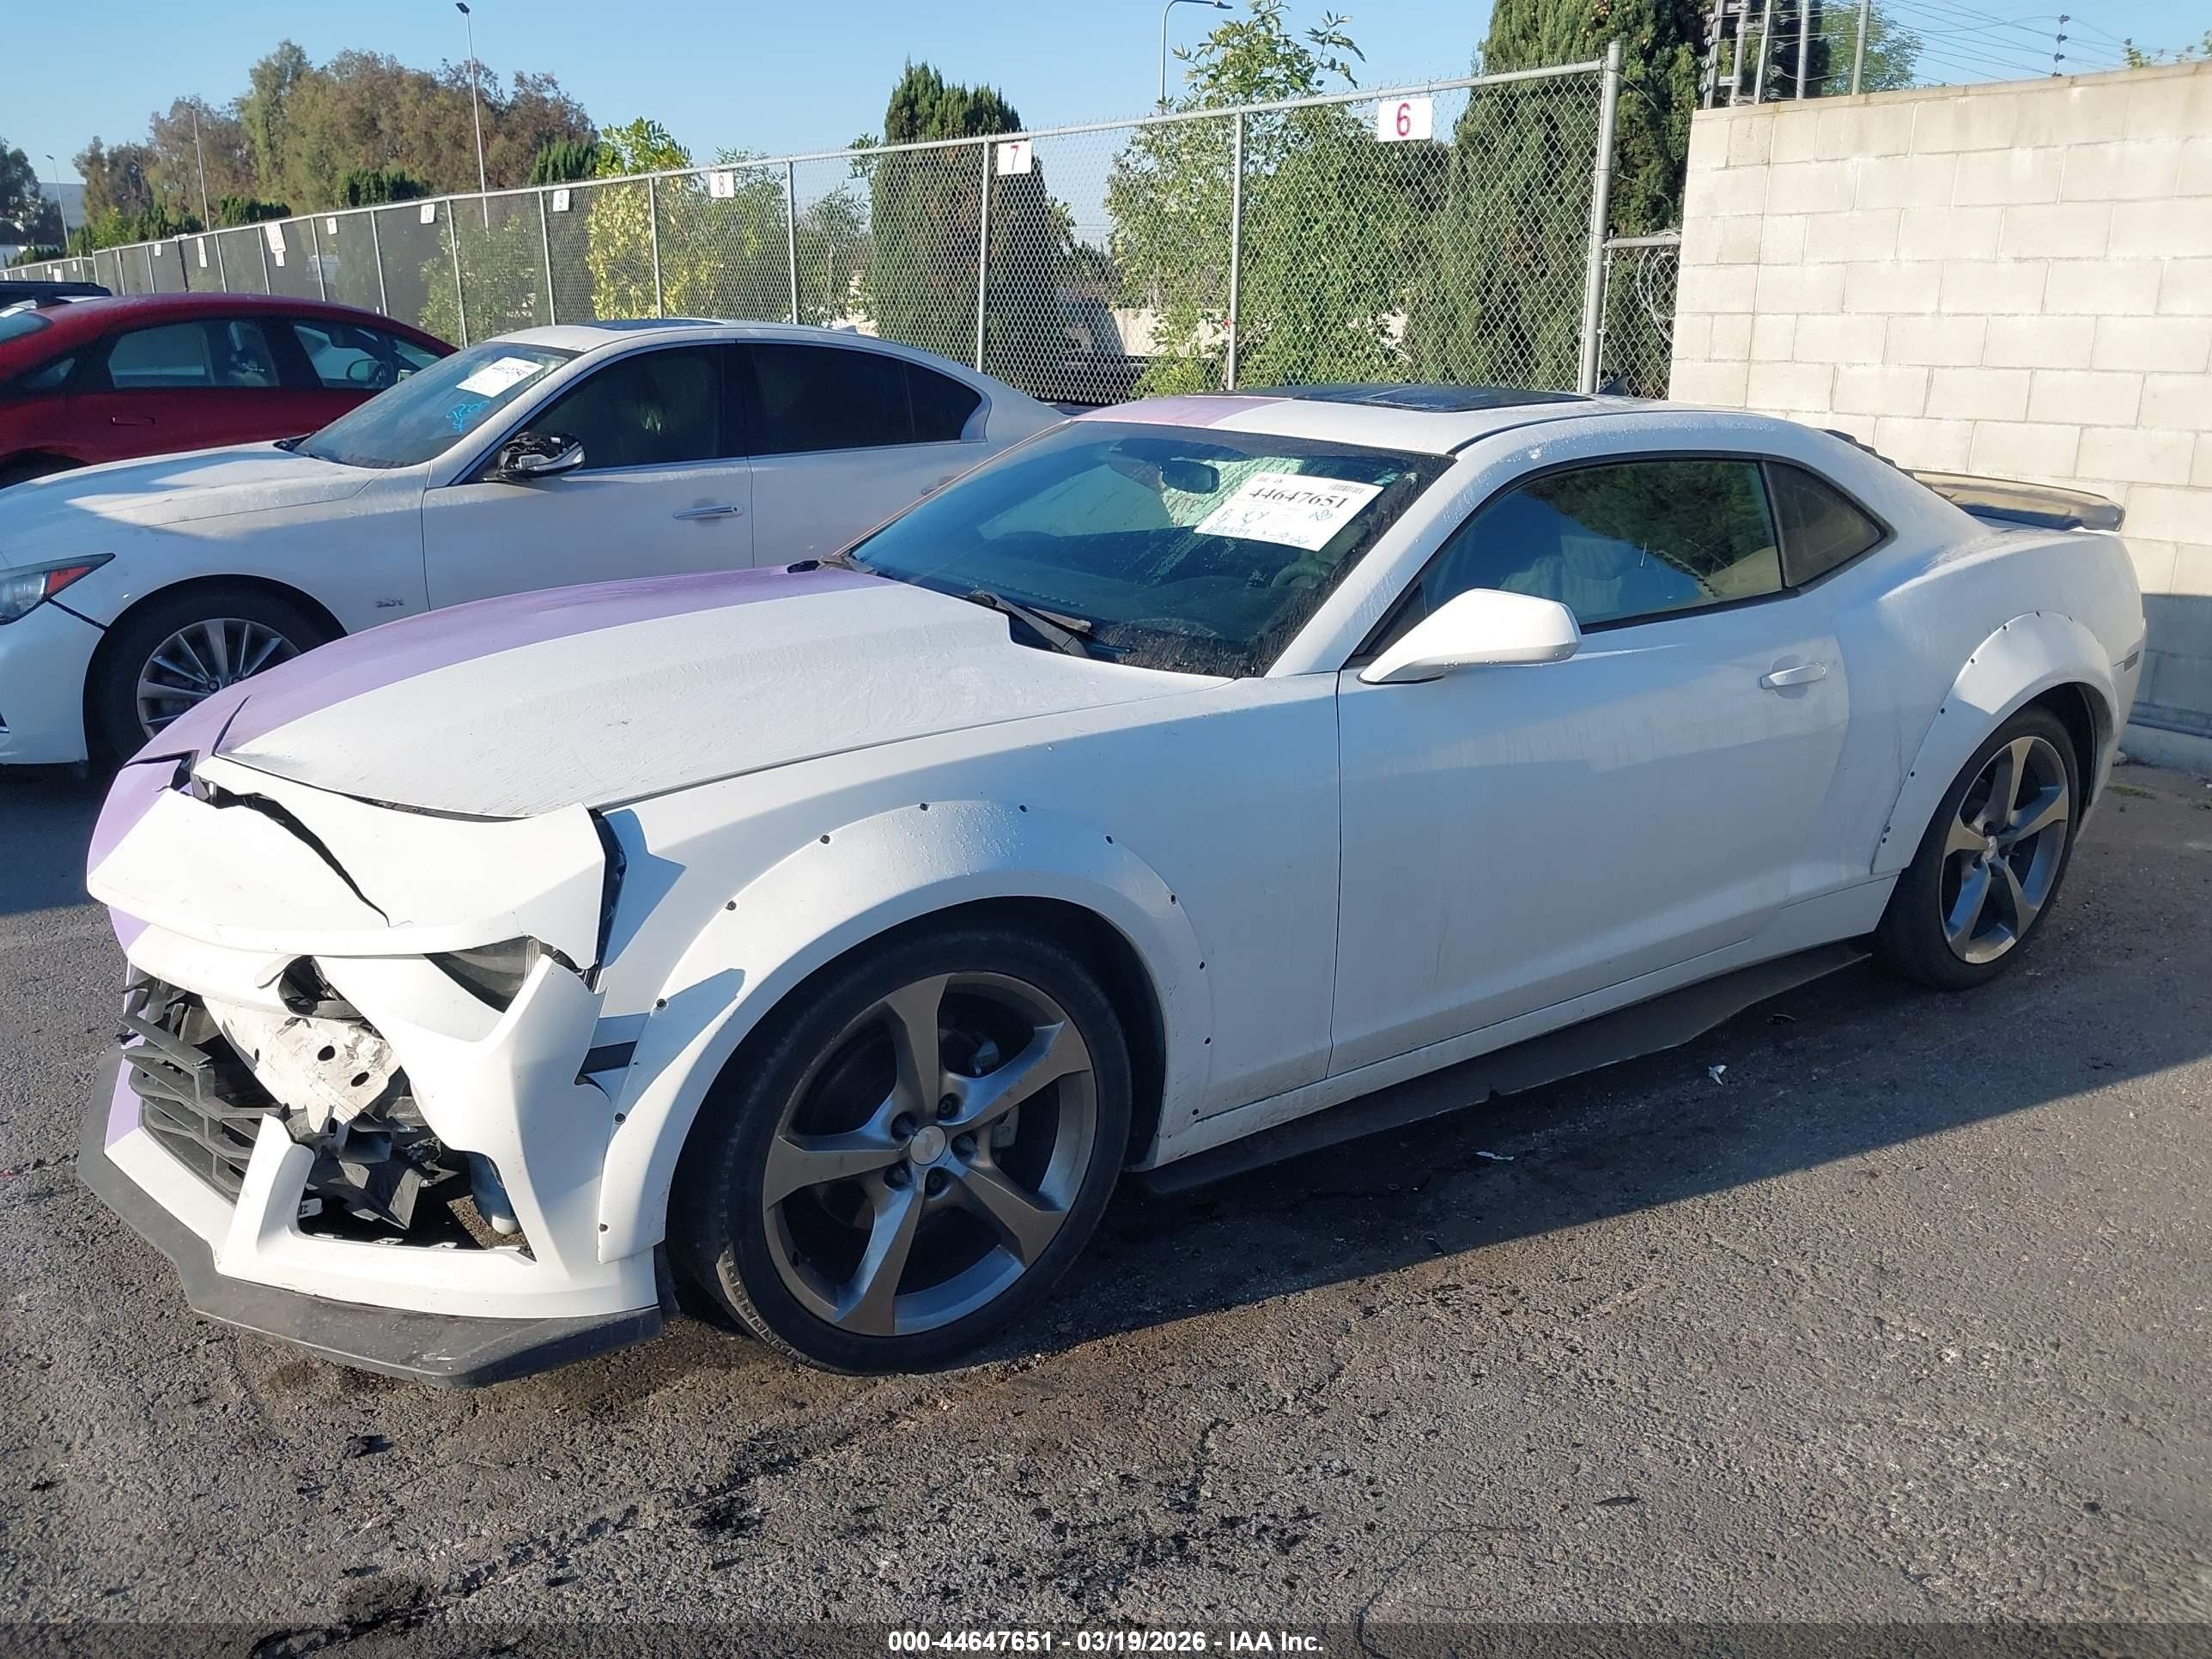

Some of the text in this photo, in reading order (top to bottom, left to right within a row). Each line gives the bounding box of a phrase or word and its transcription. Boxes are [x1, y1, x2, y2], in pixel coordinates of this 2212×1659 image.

[1396, 102, 1411, 137] 6
[1010, 144, 1019, 172] 7
[718, 174, 726, 195] 8
[558, 191, 564, 210] 9
[1249, 487, 1349, 508] 44647651
